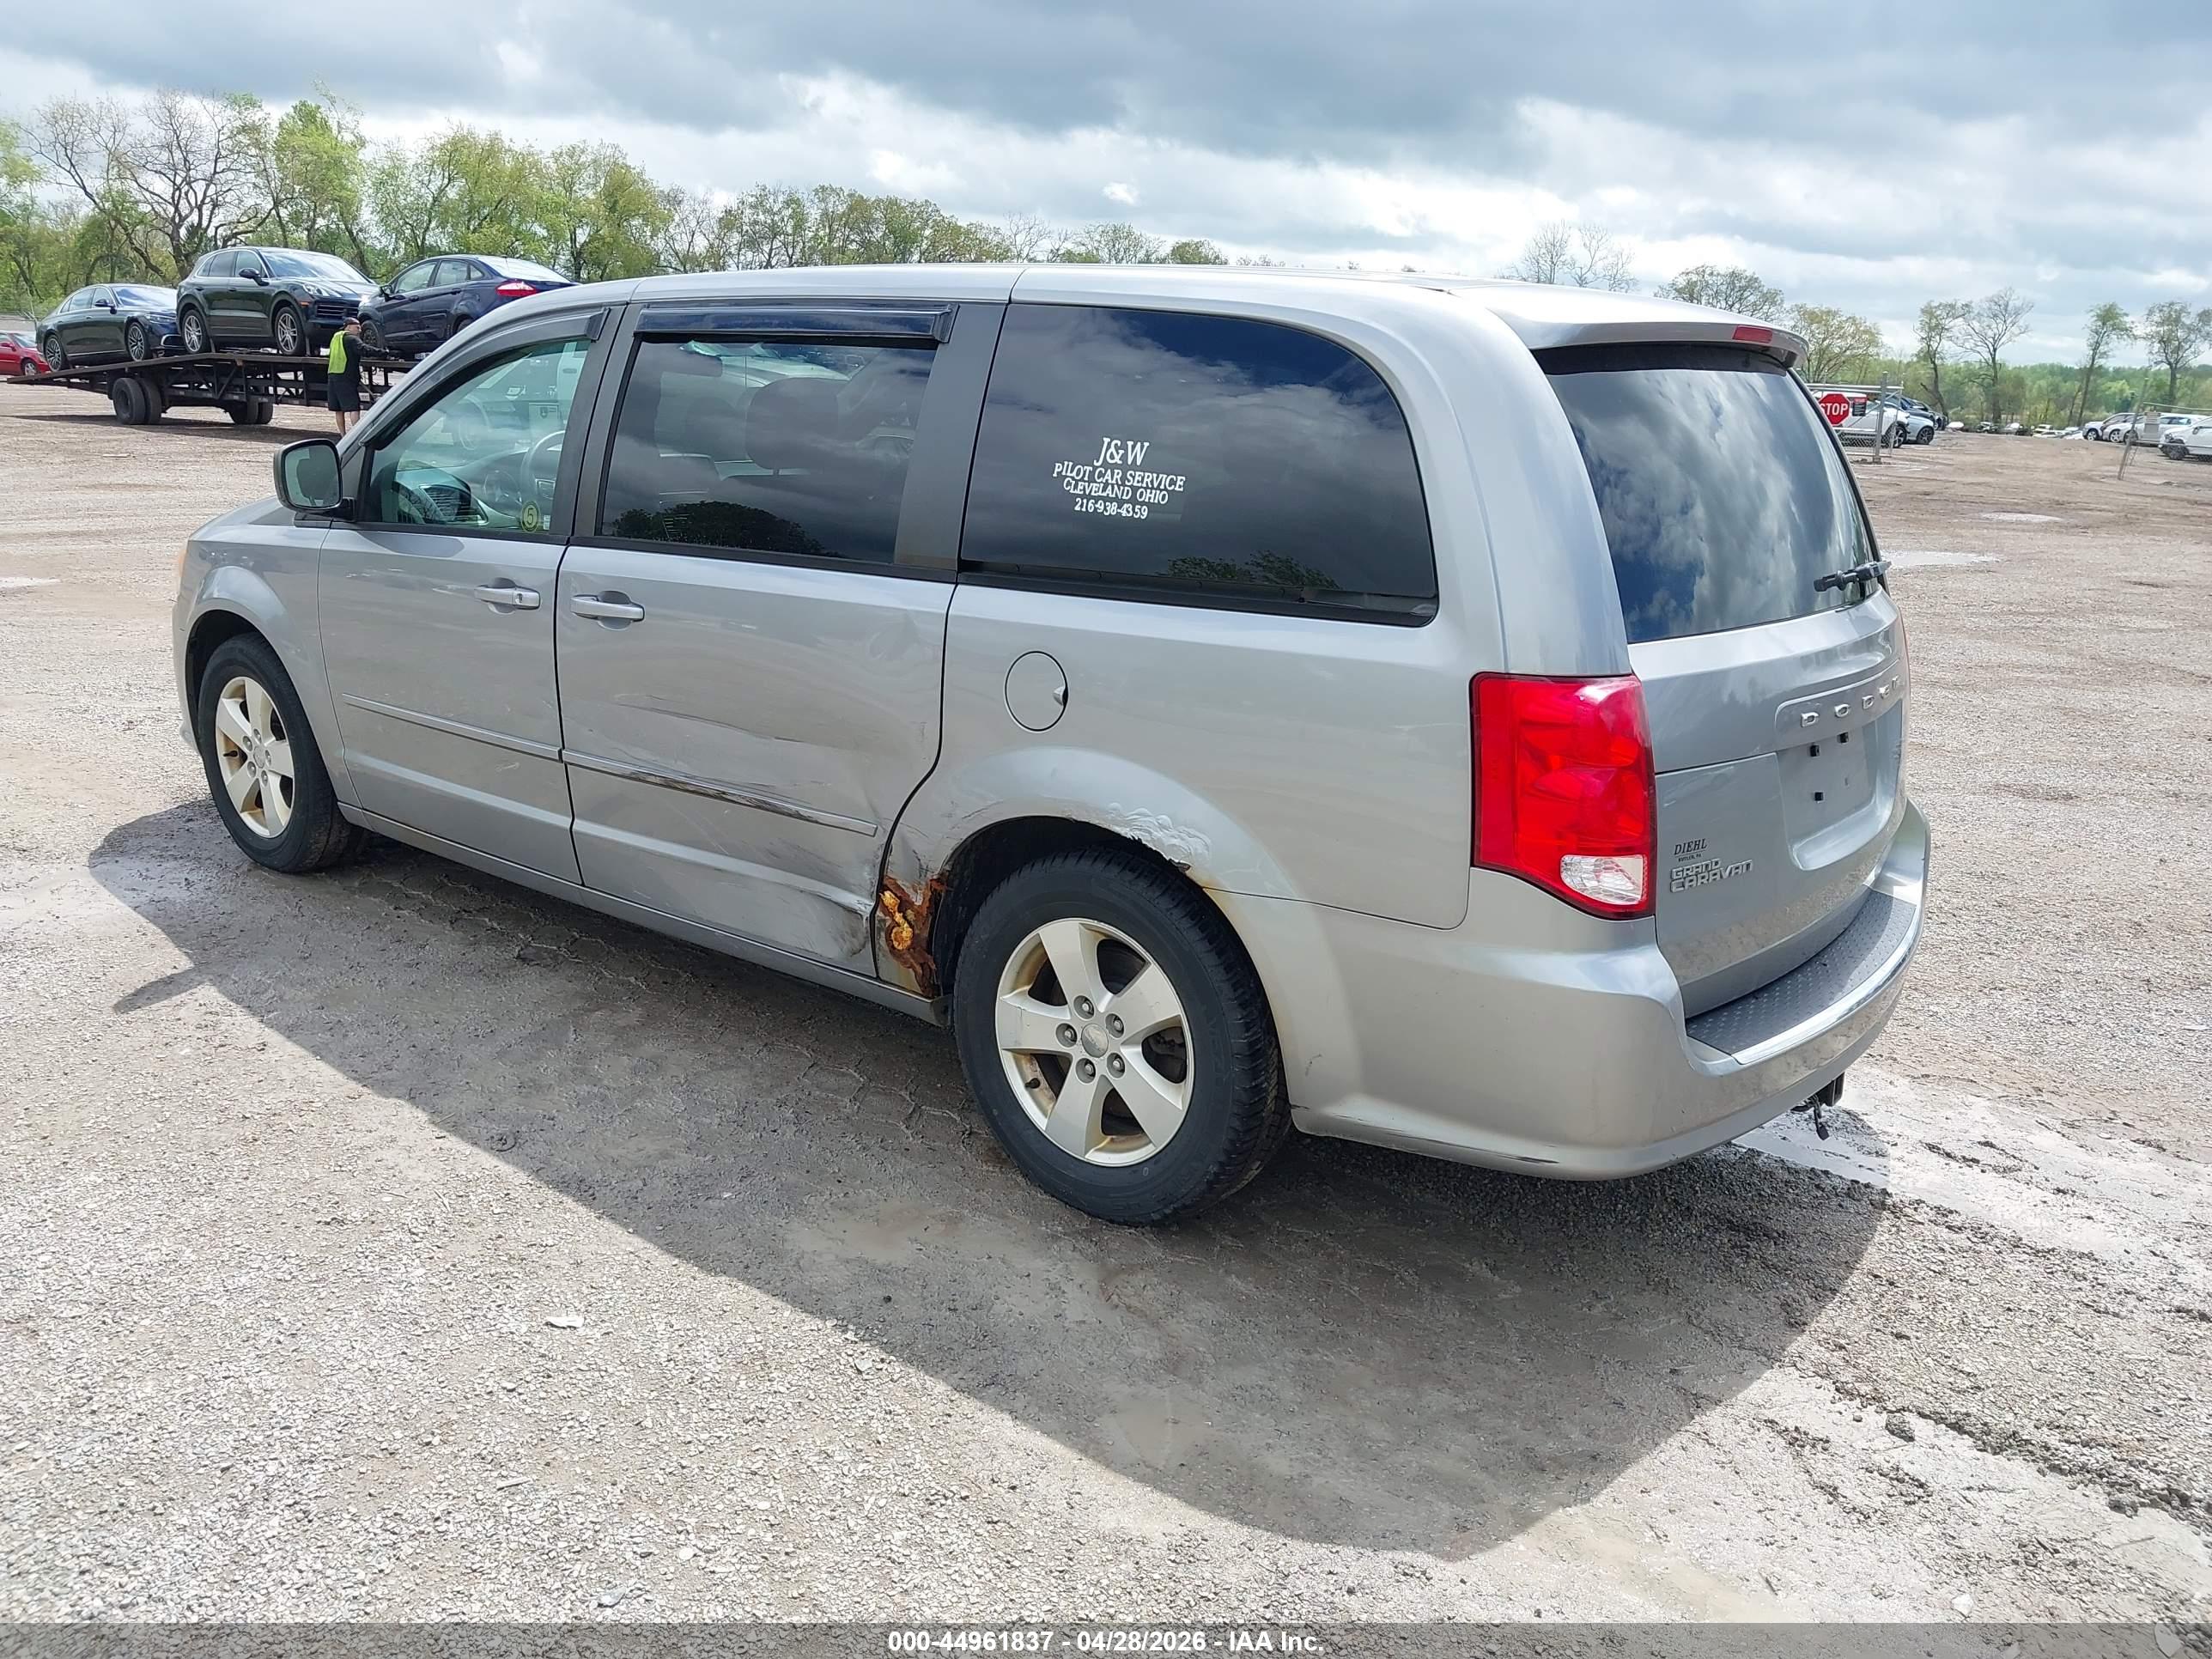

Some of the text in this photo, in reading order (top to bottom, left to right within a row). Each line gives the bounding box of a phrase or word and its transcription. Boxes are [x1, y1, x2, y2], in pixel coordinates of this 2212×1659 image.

[1093, 436, 1150, 466] J&W
[1053, 460, 1186, 492] PILOT CAR SERVICE
[1063, 477, 1169, 504] CLEVELAND OHIO
[1074, 497, 1149, 520] 216-938-4359
[1674, 838, 1708, 855] DIEHL
[1670, 859, 1754, 893] CARAVAN
[1671, 858, 1722, 880] GRAND
